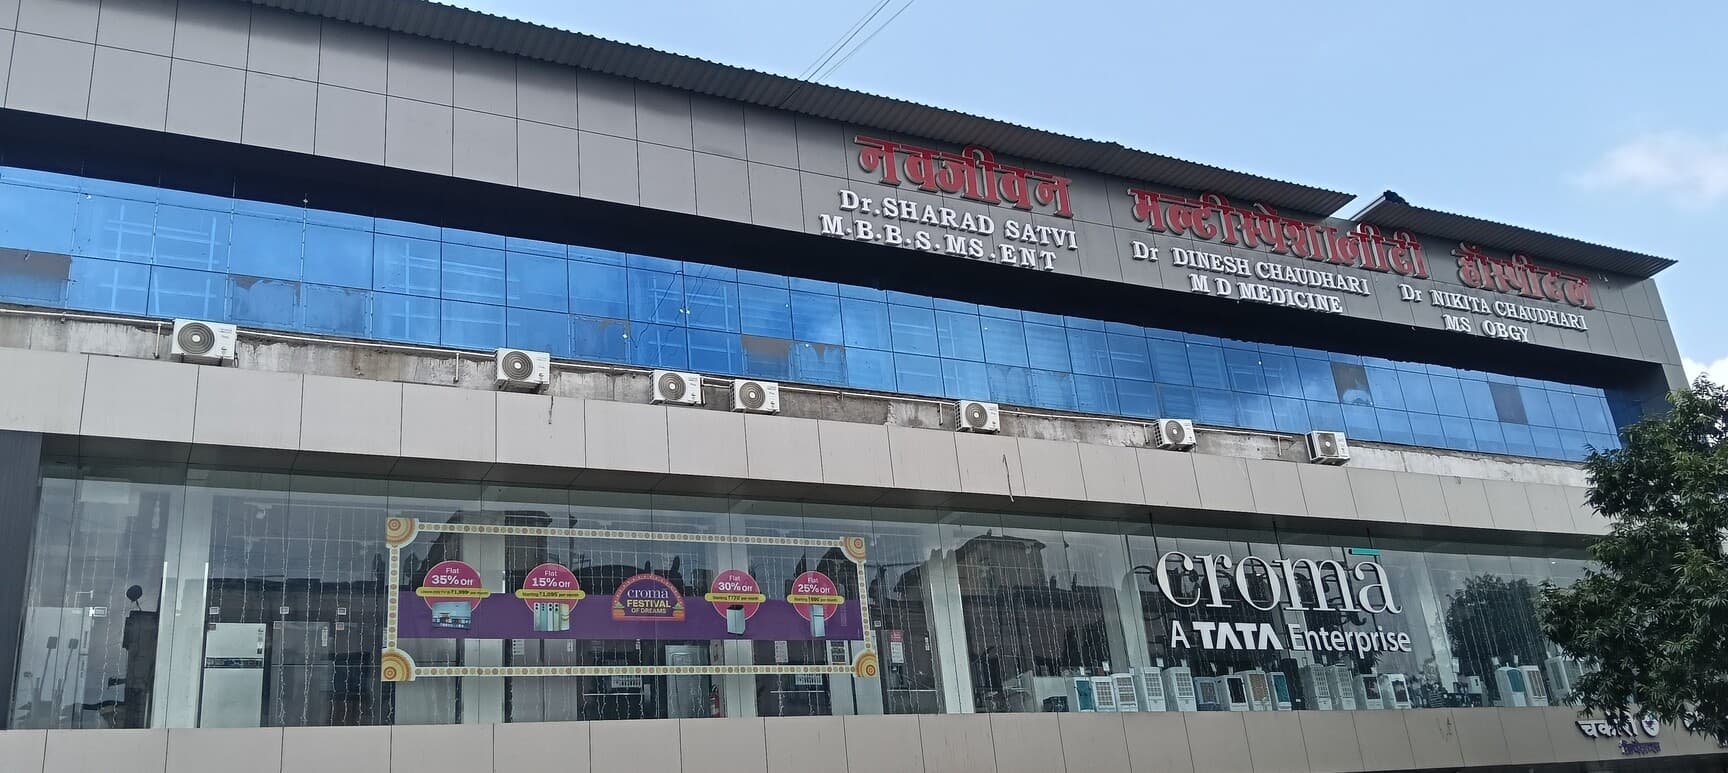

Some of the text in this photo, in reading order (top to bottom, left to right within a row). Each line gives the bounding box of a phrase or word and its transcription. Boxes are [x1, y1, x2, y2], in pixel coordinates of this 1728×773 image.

[854, 135, 1074, 218] नवजीवन
[839, 190, 1078, 250] Dr.SHARAD SATVI
[1132, 241, 1371, 296] Dr DINESH CHAUDHARI
[1188, 273, 1343, 313] M D MEDICINE
[1399, 284, 1589, 331] Dr NIKITA CHAUDHARI
[1442, 314, 1530, 343] MS OBGY
[431, 575, 474, 586] 35% Off
[446, 567, 459, 575] Flat
[532, 577, 558, 587] 15%
[1156, 548, 1403, 614] croma
[627, 588, 669, 598] croma
[718, 582, 741, 591] 30%
[798, 584, 819, 592] 25%
[627, 599, 671, 608] FESTIVAL
[1170, 621, 1413, 658] A TATA Enterprise
